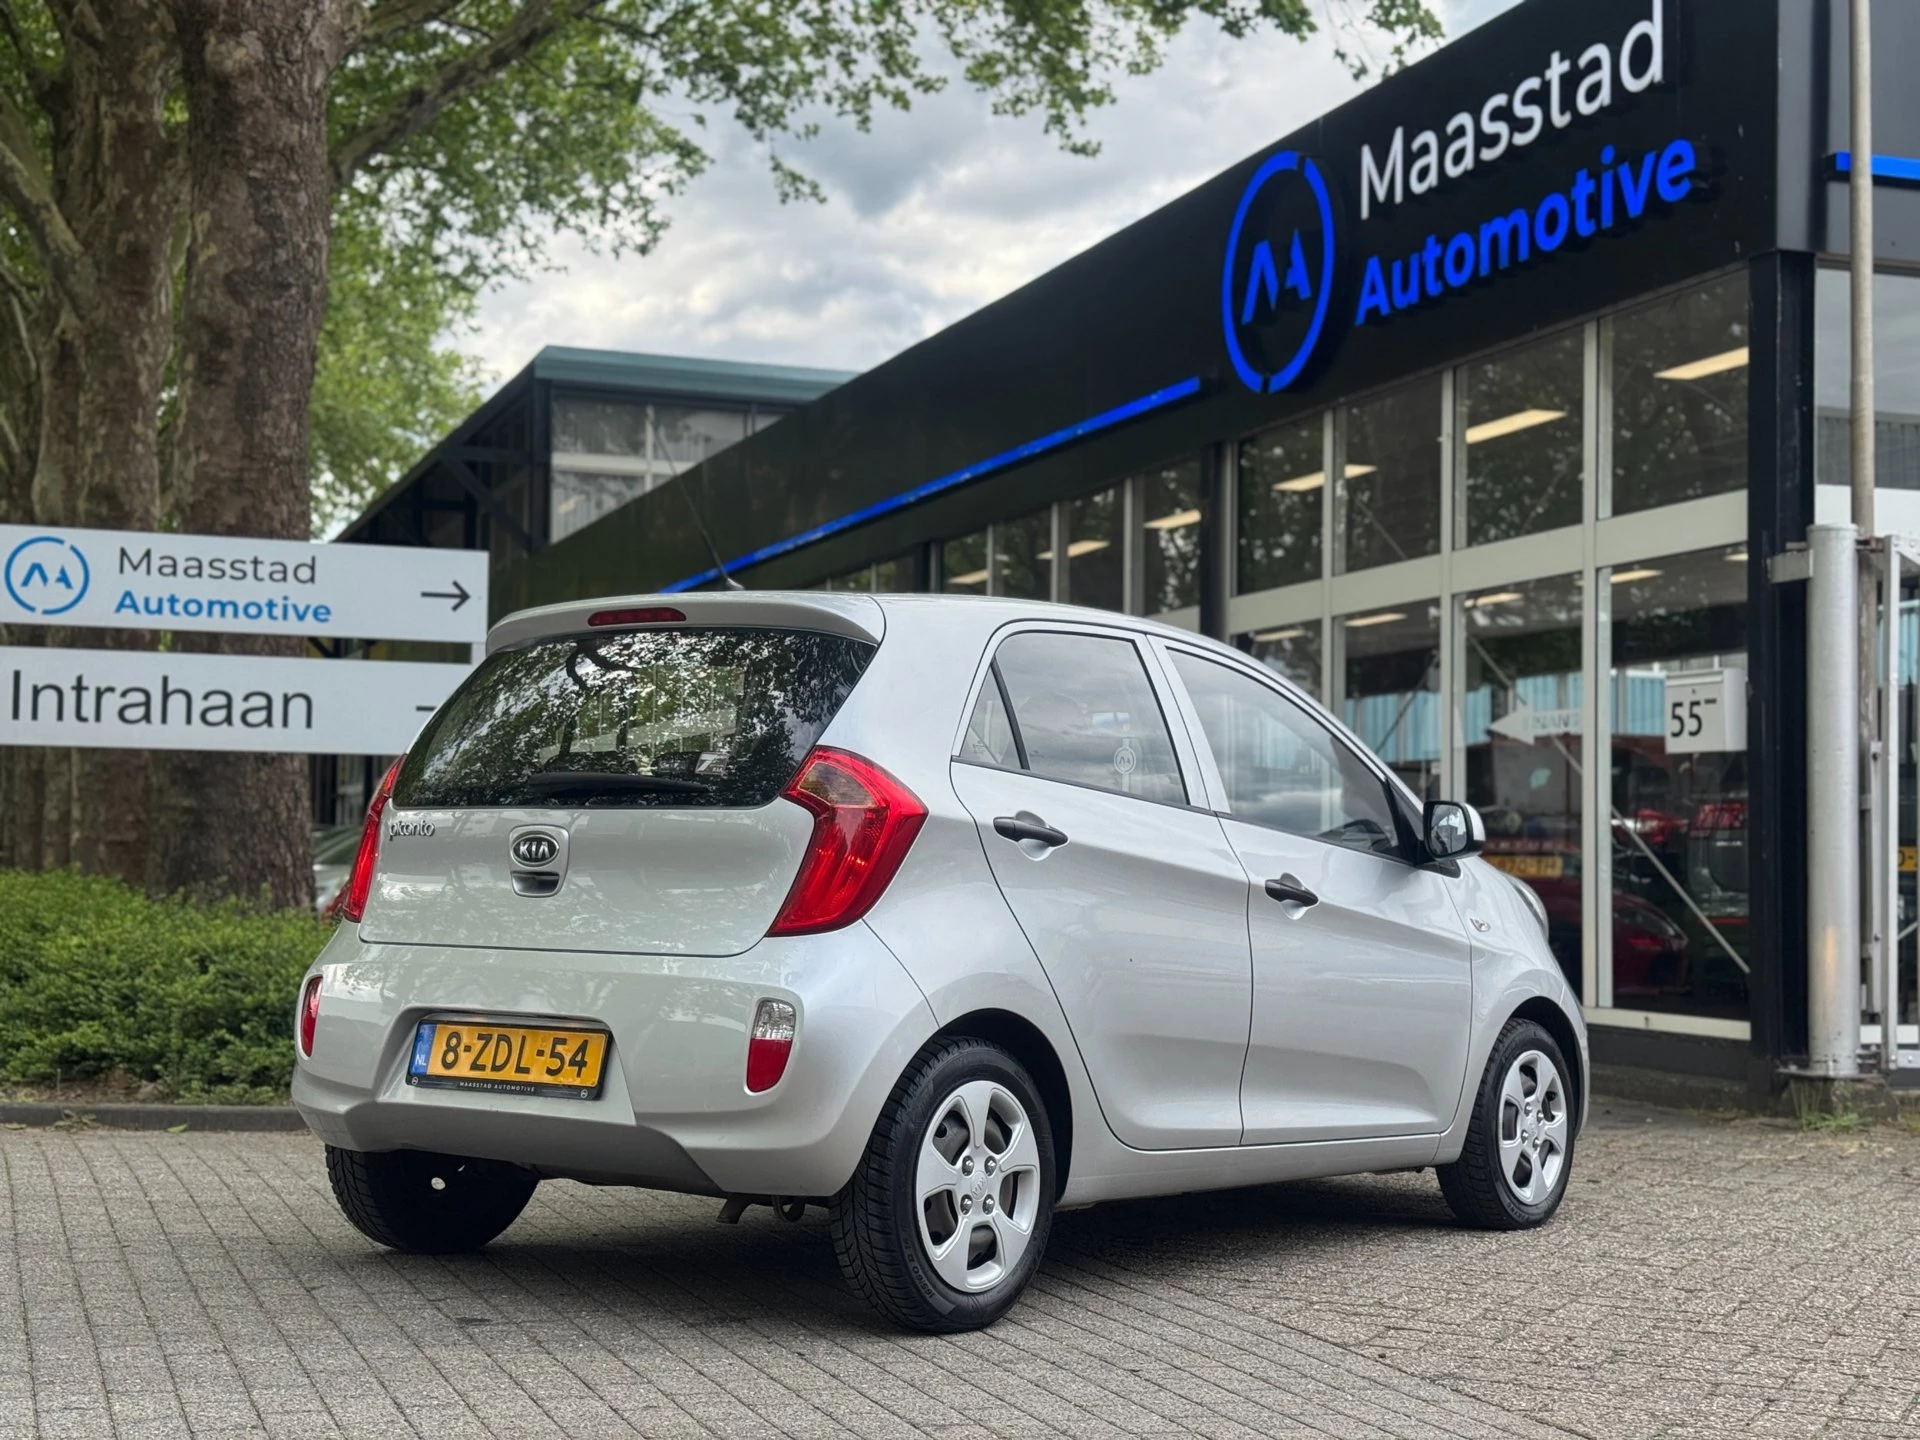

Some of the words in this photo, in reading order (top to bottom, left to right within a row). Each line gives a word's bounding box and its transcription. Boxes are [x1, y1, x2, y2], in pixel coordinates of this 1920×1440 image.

[1361, 0, 1664, 220] Maasstad
[1355, 138, 1696, 326] Automotive
[117, 546, 317, 585] Maasstad
[114, 590, 333, 623] Automotive
[10, 669, 314, 730] Intrahaan
[519, 841, 550, 859] KIA
[415, 1053, 427, 1066] NL
[440, 1031, 588, 1079] 8-ZDL-54
[459, 1081, 492, 1089] MAASSTAD
[494, 1083, 536, 1093] AUTOMOTIVE
